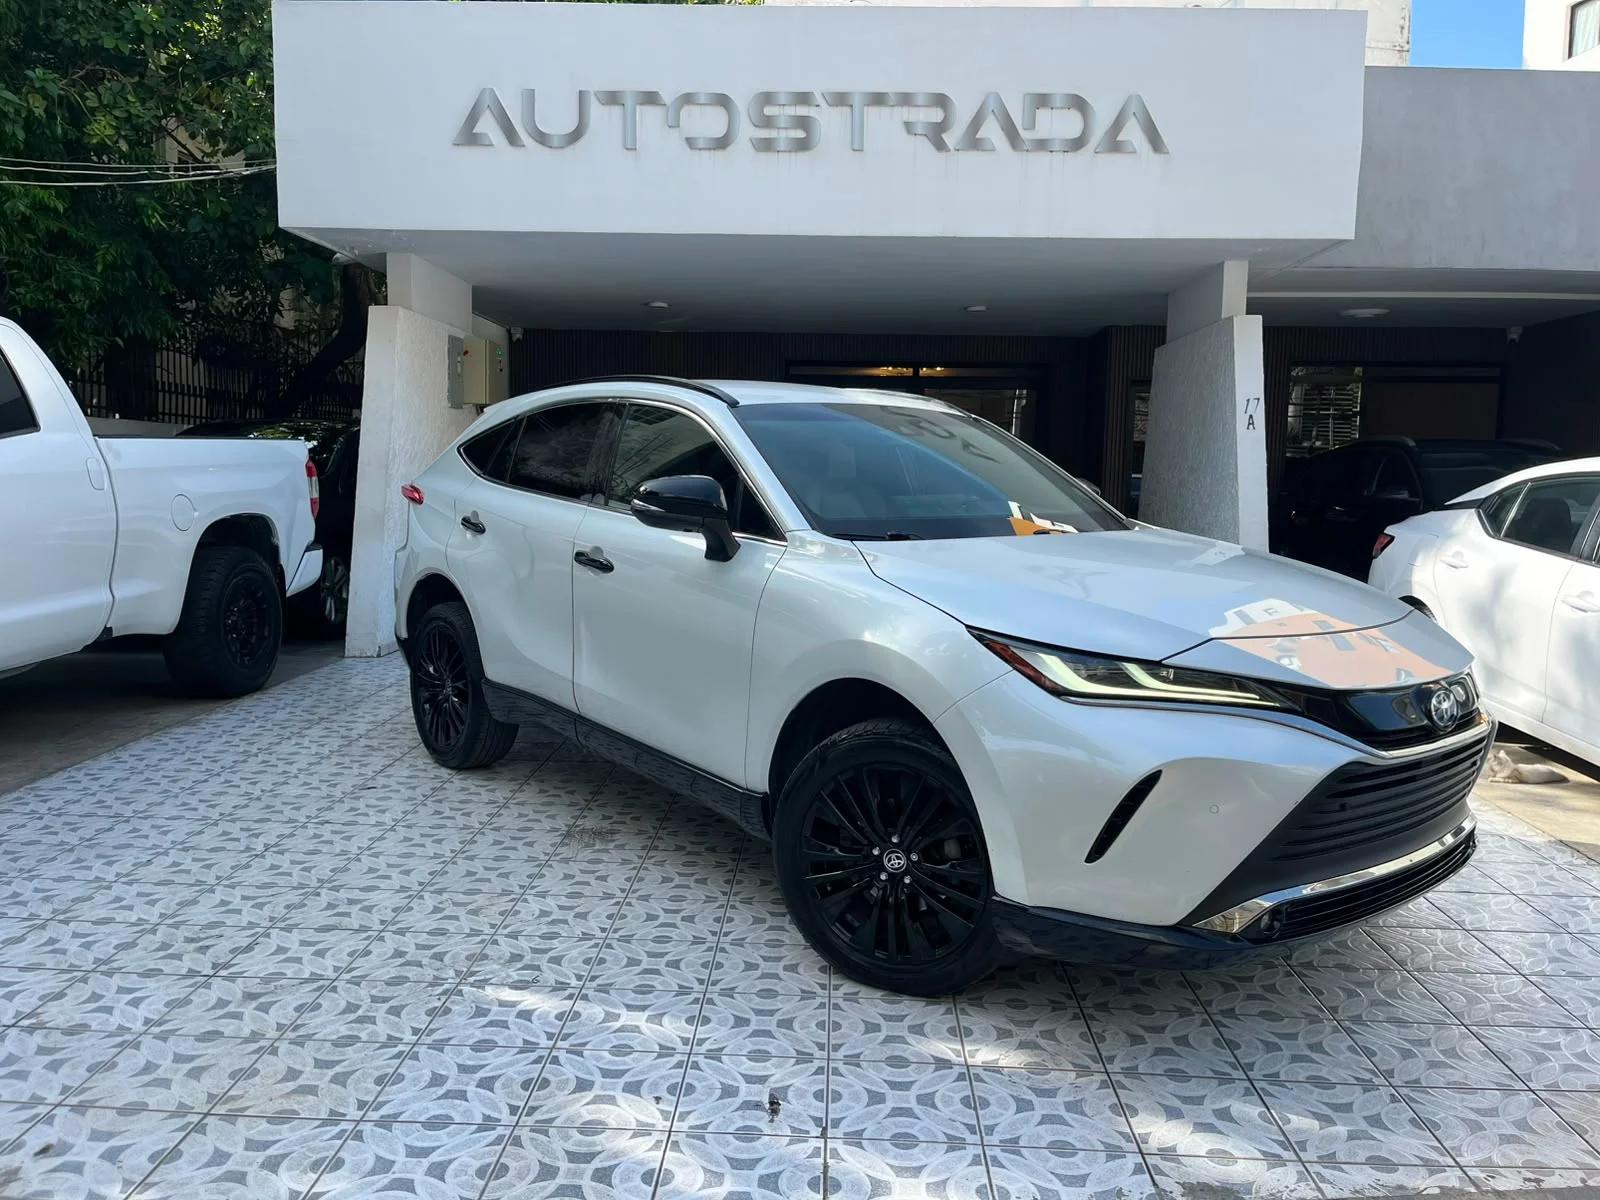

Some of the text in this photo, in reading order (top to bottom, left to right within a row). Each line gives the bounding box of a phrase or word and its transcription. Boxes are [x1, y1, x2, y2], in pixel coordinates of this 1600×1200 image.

[453, 88, 1169, 154] AUTOSTRADA
[1244, 397, 1261, 414] 17
[1246, 414, 1256, 430] A
